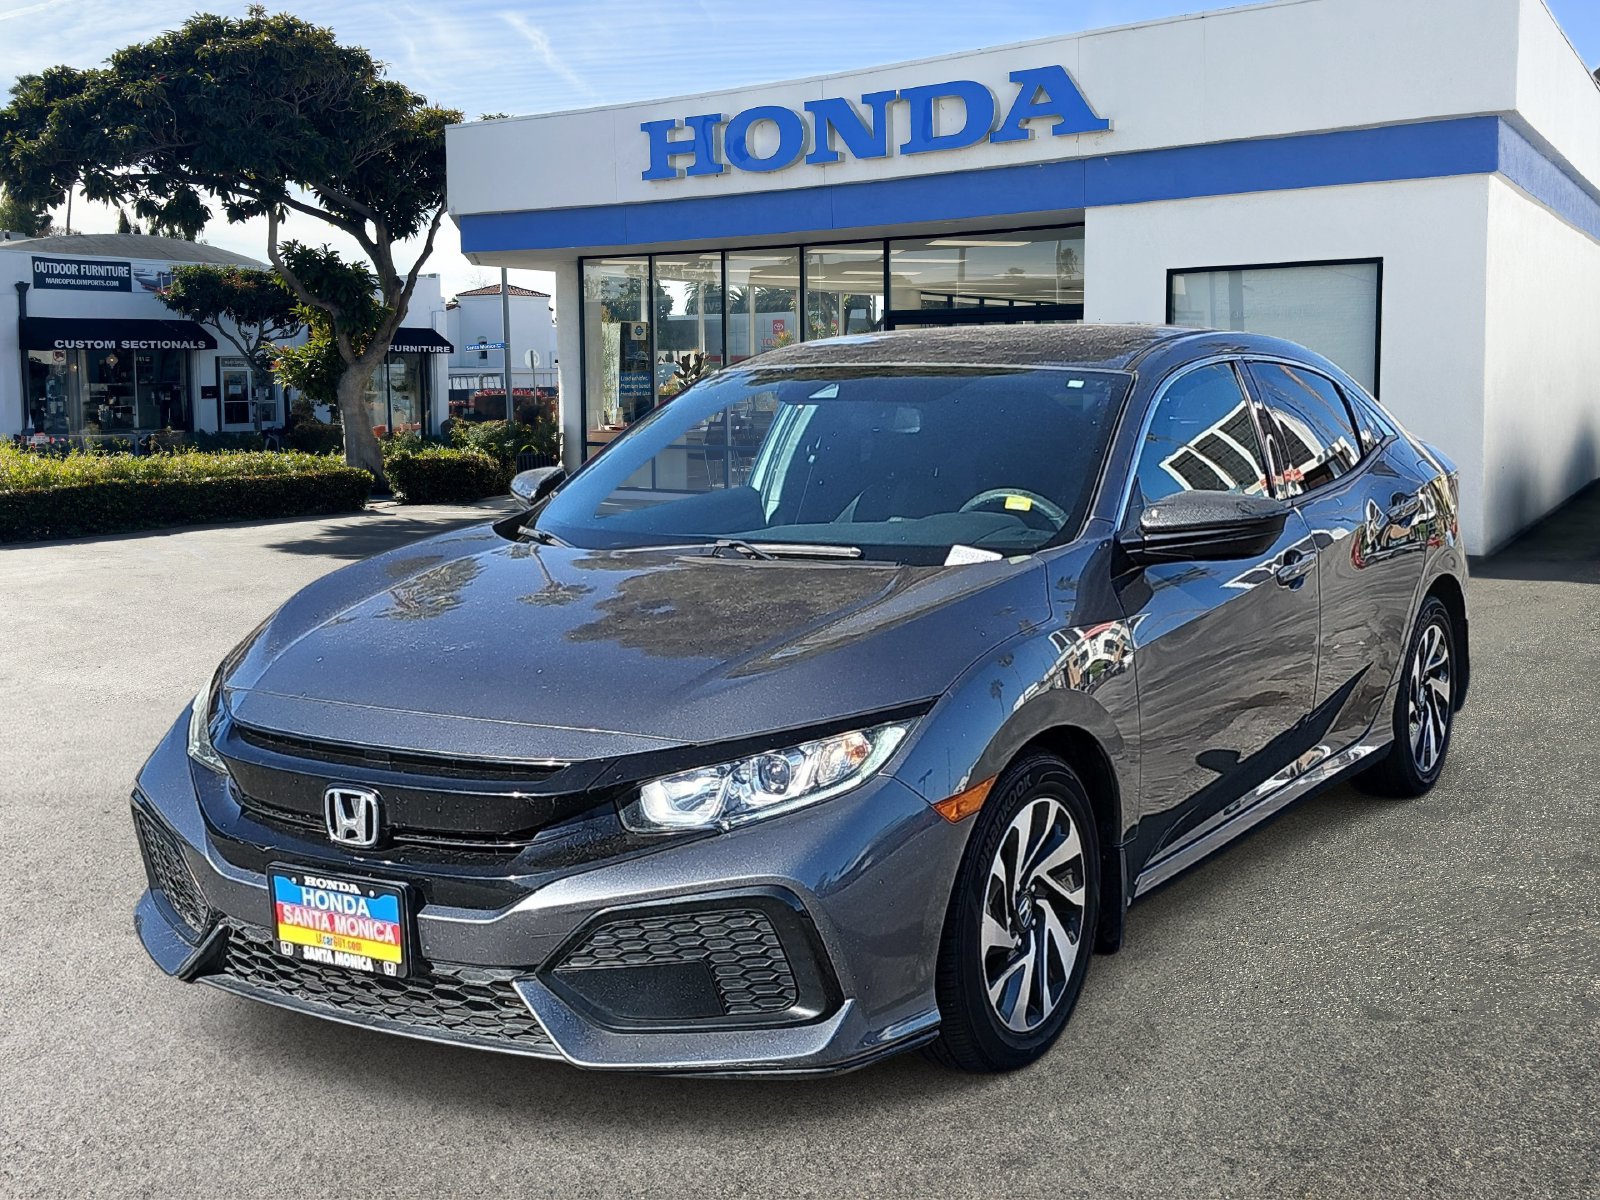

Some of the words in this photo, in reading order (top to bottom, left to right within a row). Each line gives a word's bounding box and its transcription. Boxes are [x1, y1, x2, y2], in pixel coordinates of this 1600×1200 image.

[641, 65, 1111, 181] HONDA
[34, 261, 78, 275] OUTDOOR
[80, 264, 130, 277] FURNITURE
[54, 339, 116, 349] CUSTOM
[121, 340, 206, 349] SECTIONALS
[388, 344, 451, 353] FURNITURE
[303, 875, 362, 895] HONDA
[301, 887, 371, 917] HONDA
[283, 905, 332, 932] SANTA
[334, 912, 396, 944] MONICA
[303, 945, 335, 964] SANTA
[334, 950, 375, 972] MONICA
